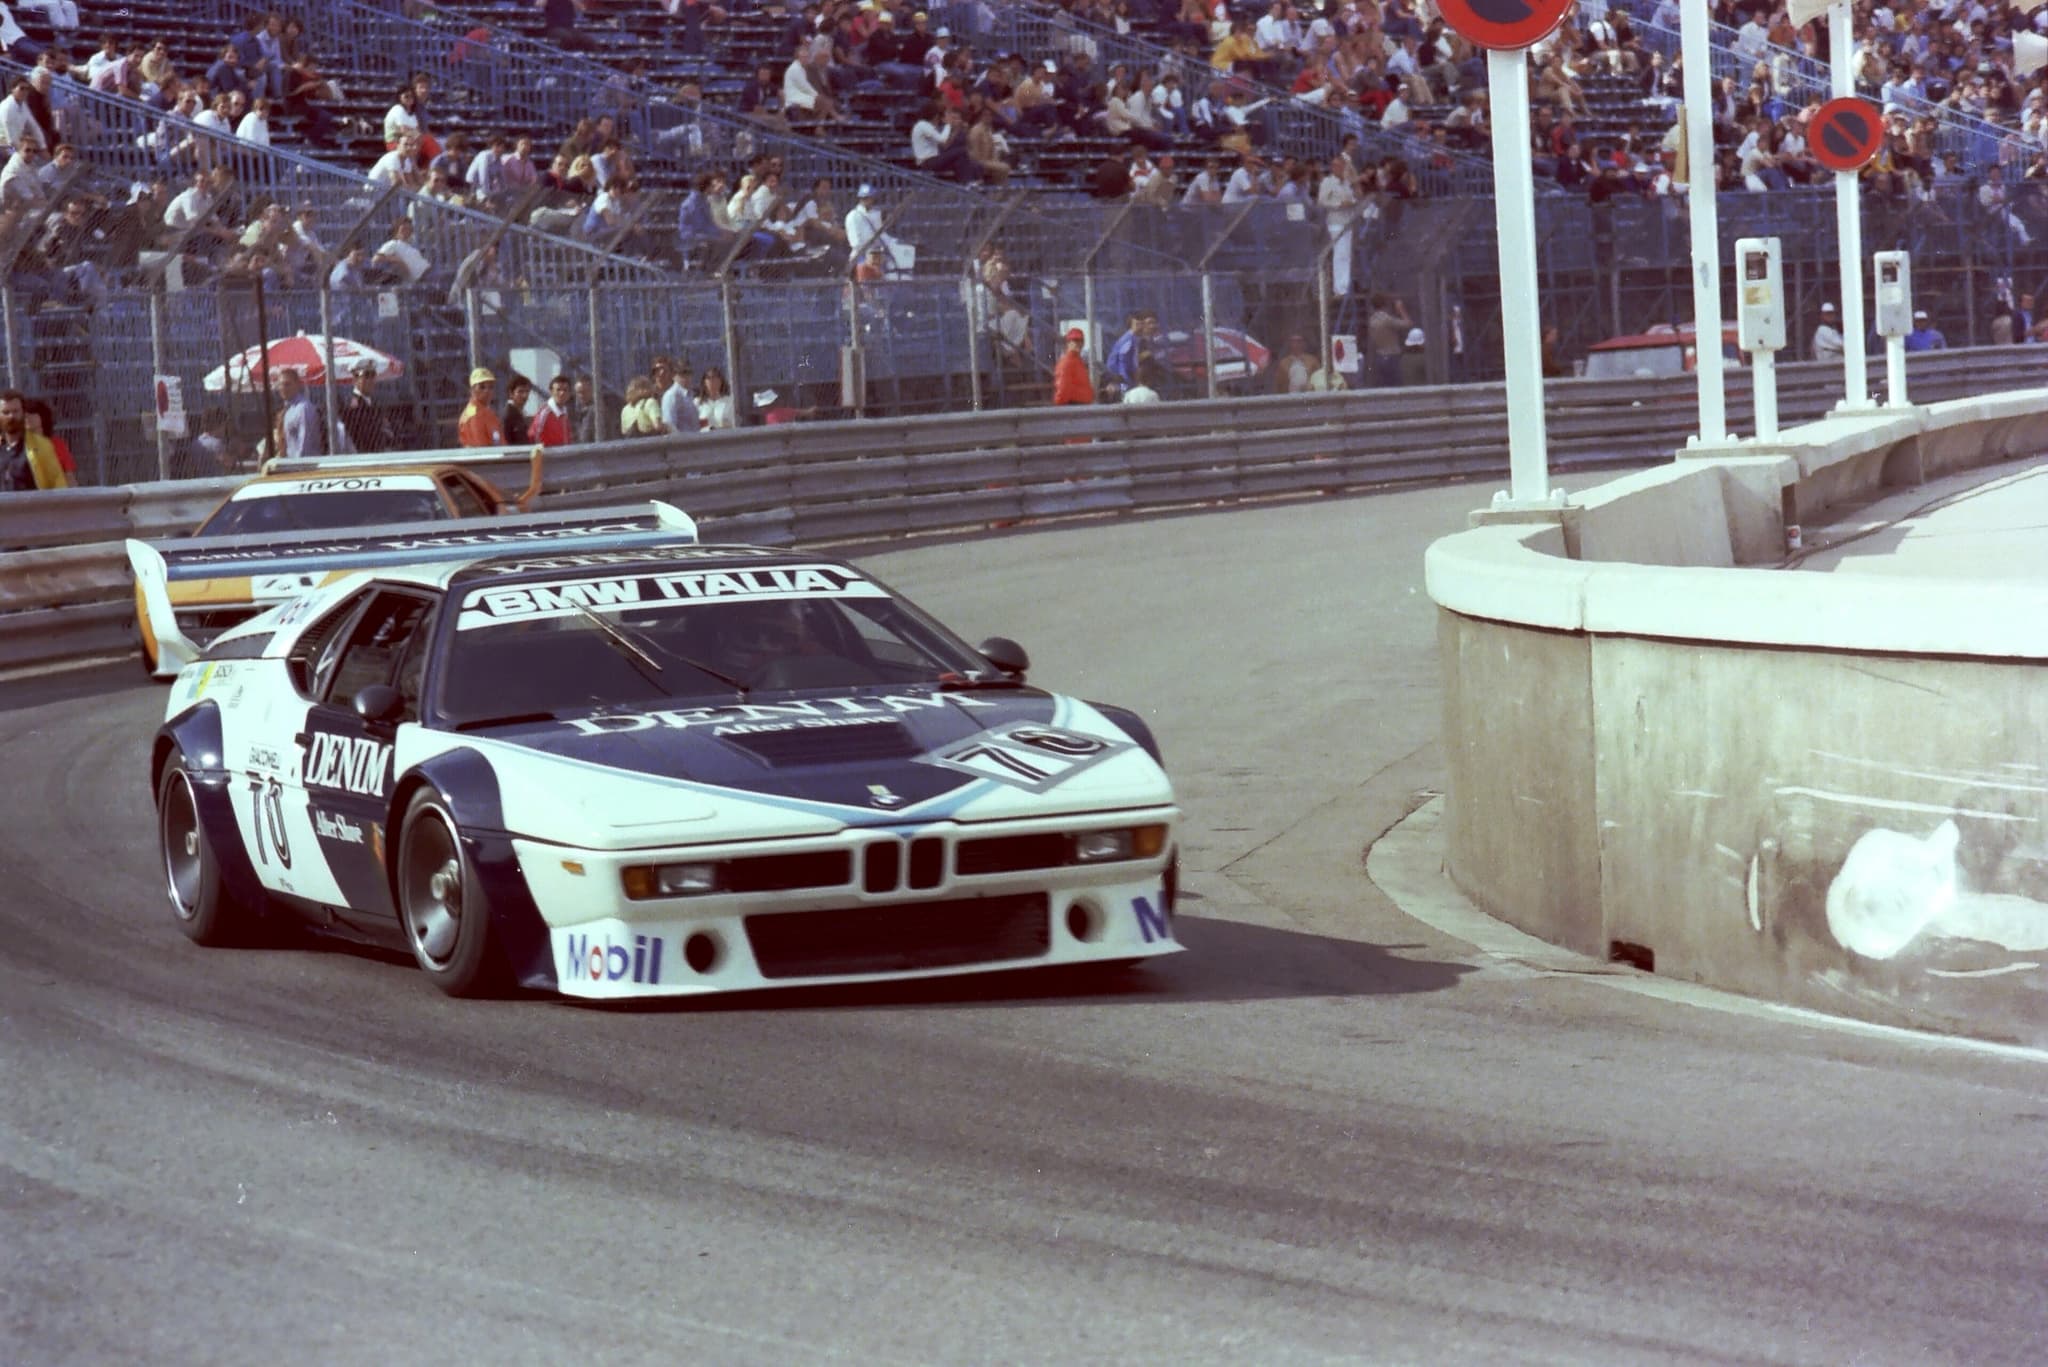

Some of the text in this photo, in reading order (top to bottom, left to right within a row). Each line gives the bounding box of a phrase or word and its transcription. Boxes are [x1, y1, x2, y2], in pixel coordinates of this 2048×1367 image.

[483, 568, 841, 617] BMW ITALIA
[558, 691, 998, 736] DENIM
[304, 731, 394, 797] DENIM
[940, 730, 1111, 784] 70
[246, 770, 291, 870] 70
[566, 934, 664, 985] Mobil
